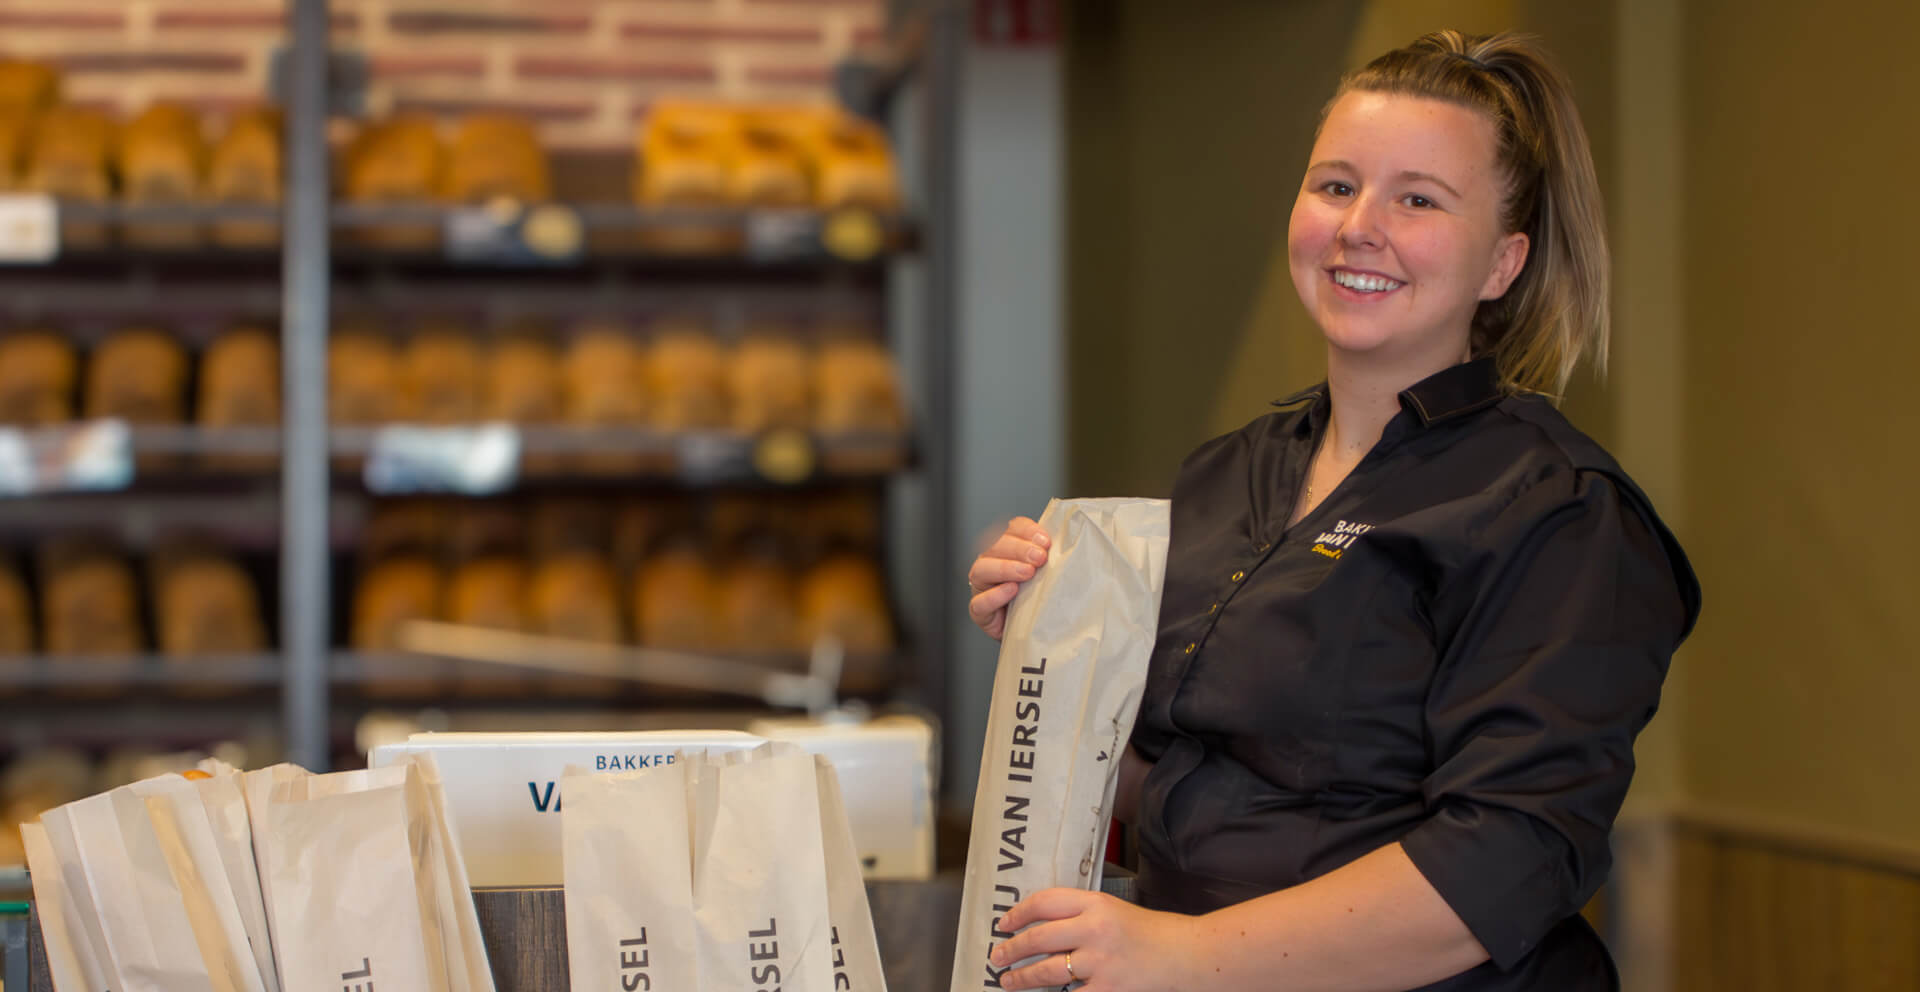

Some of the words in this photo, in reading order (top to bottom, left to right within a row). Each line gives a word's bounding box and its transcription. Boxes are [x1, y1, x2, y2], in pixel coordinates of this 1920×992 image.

[1008, 657, 1047, 783] IERSEL
[528, 781, 561, 813] V
[997, 796, 1031, 873] VAN
